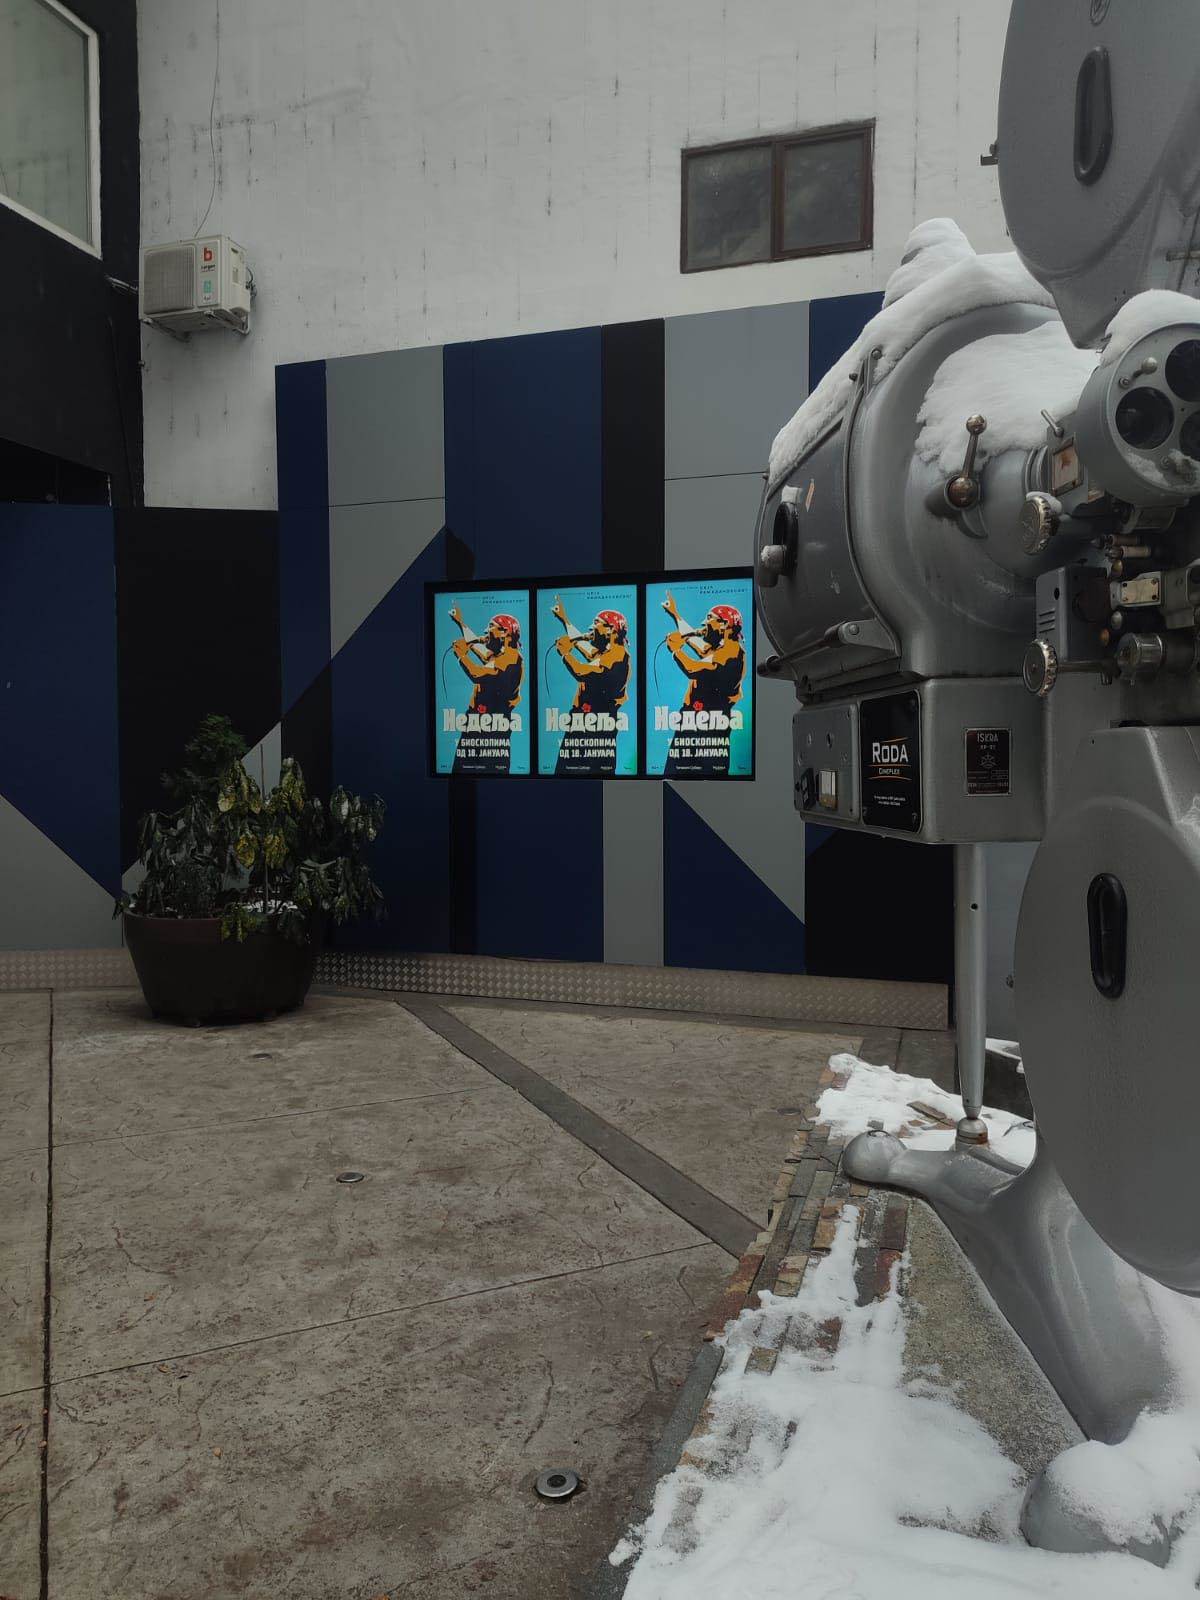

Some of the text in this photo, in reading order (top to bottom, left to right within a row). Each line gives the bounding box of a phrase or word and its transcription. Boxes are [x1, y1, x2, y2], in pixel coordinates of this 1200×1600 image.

[443, 708, 522, 734] Недеља
[545, 707, 629, 733] Недеља
[654, 705, 744, 732] Недеља
[461, 738, 511, 747] БИОСКОПИМА
[564, 738, 617, 747] БИОСКОПИМА
[674, 737, 730, 746] БИОСКОПИМА
[456, 748, 466, 758] ОД
[479, 748, 510, 758] ЈАНУАРА
[559, 748, 570, 759] ОД
[583, 748, 615, 758] ЈАНУАРА
[669, 748, 680, 759] ОД
[694, 748, 729, 758] ЈАНУАРА
[872, 742, 909, 763] RODA
